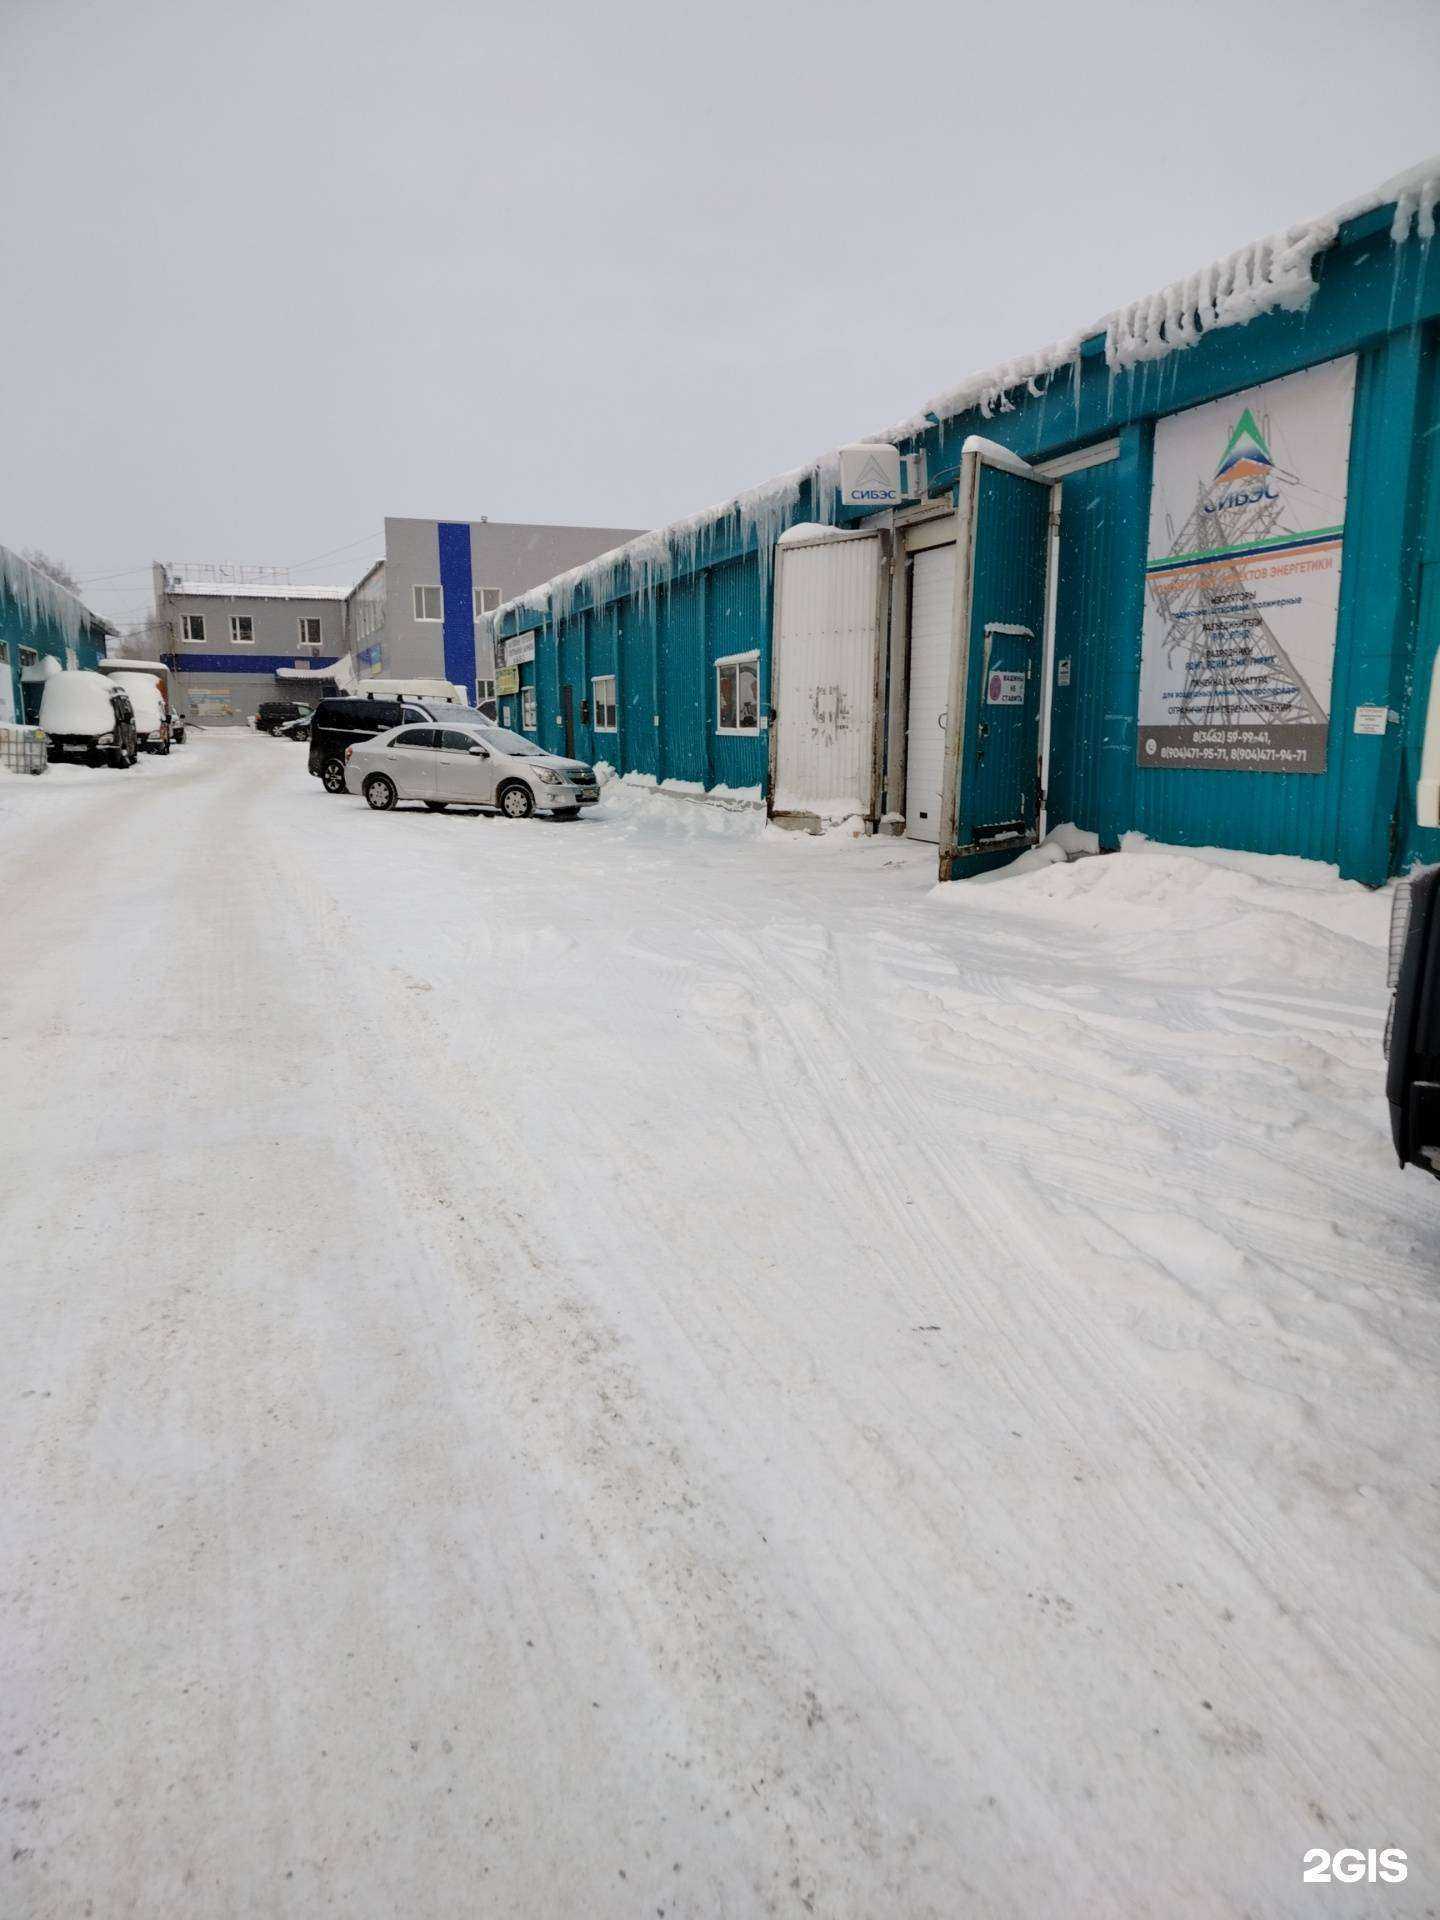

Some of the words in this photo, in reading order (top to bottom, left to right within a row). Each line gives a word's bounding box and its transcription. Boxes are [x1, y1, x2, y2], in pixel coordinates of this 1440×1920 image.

[851, 490, 896, 499] СИБЭС
[1269, 558, 1332, 578] ЭНЕРГЕТИКИ
[1193, 729, 1225, 744] 8(3462)
